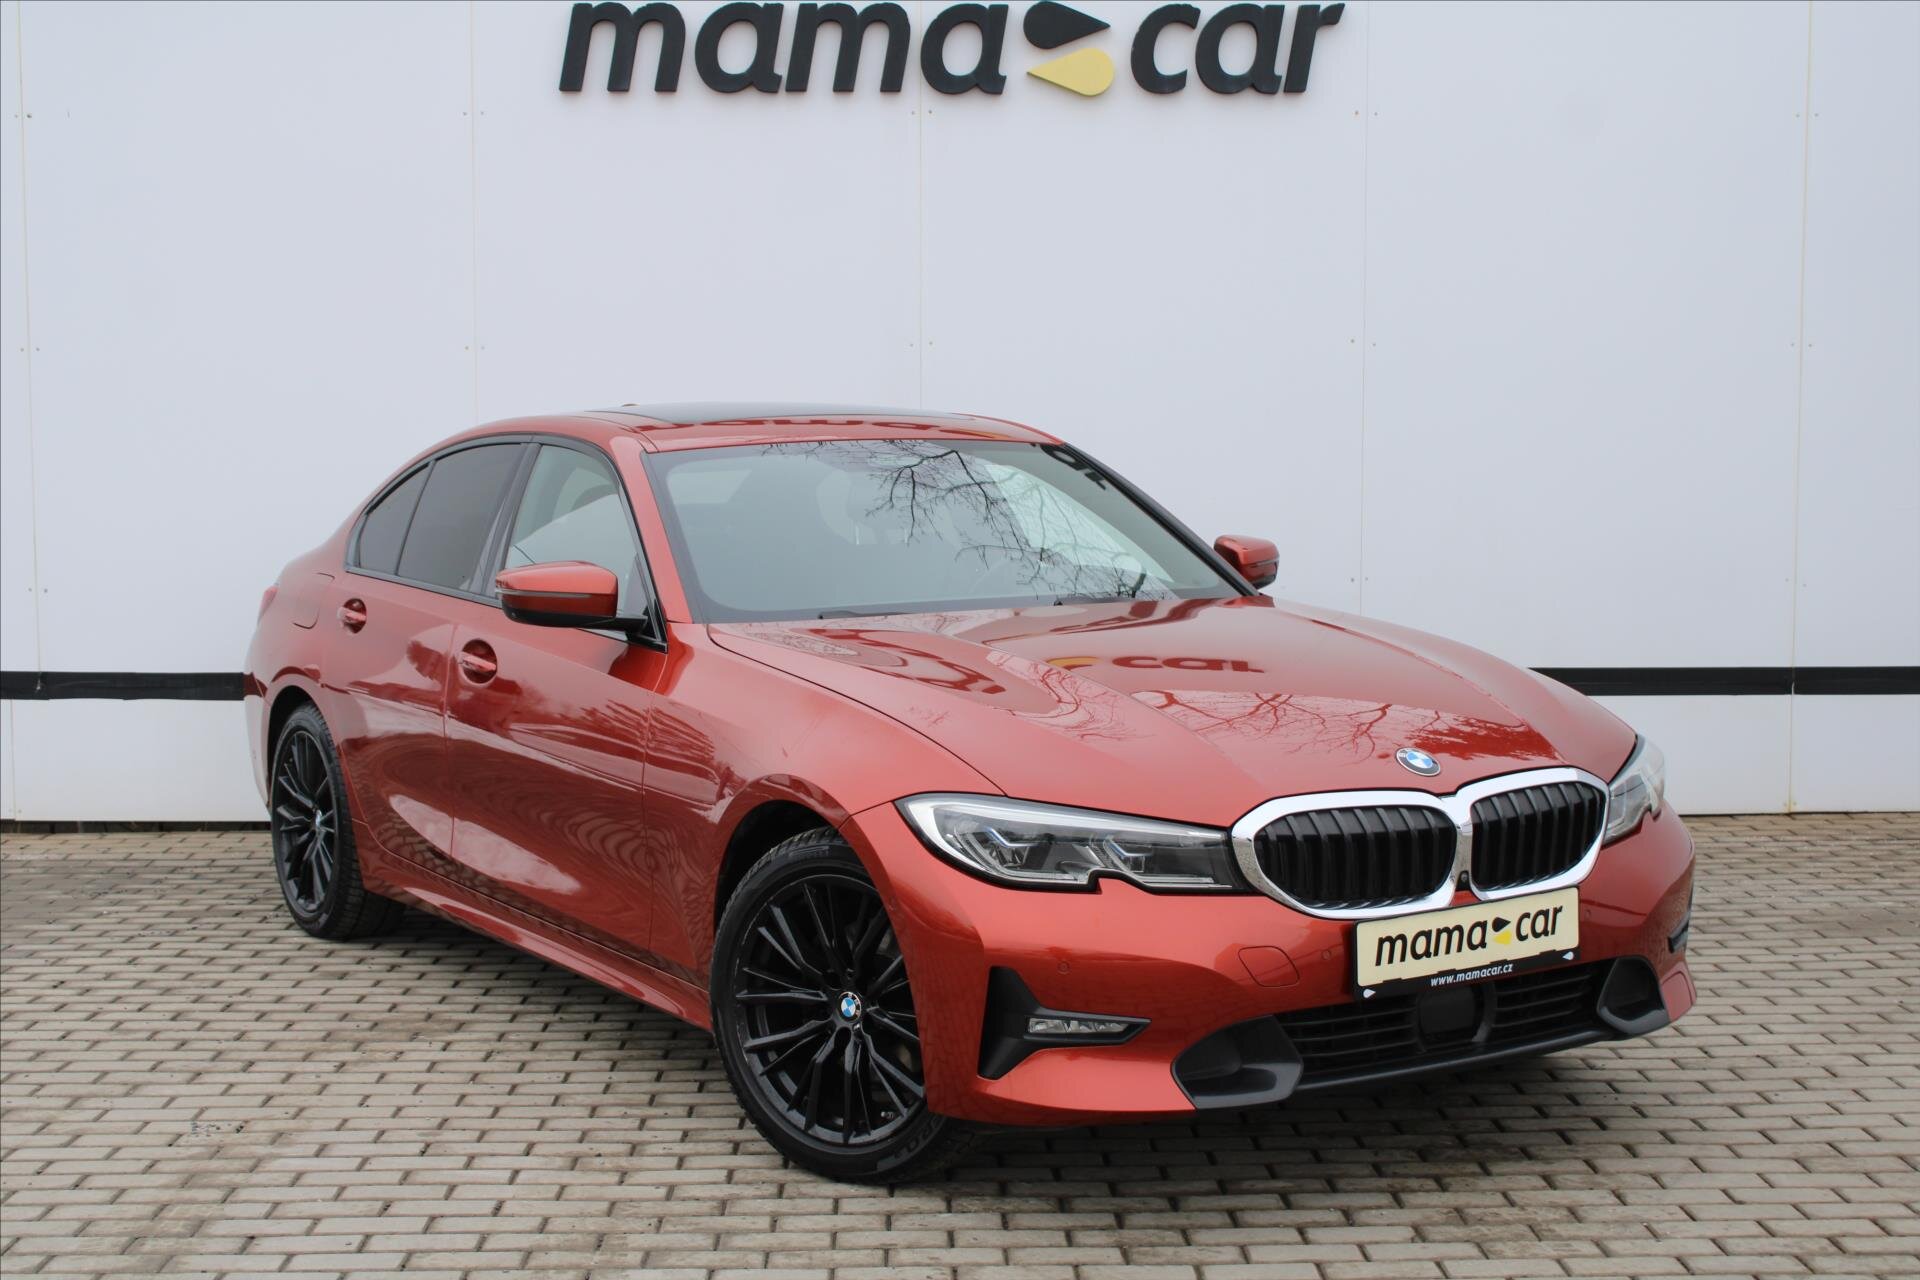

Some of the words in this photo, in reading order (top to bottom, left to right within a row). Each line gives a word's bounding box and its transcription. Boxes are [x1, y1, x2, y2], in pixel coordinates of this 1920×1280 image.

[558, 1, 1006, 95] mama
[1130, 2, 1345, 95] car
[1375, 919, 1488, 967] mama
[1515, 904, 1563, 942] car
[1430, 962, 1513, 987] www.mamacar.cz
